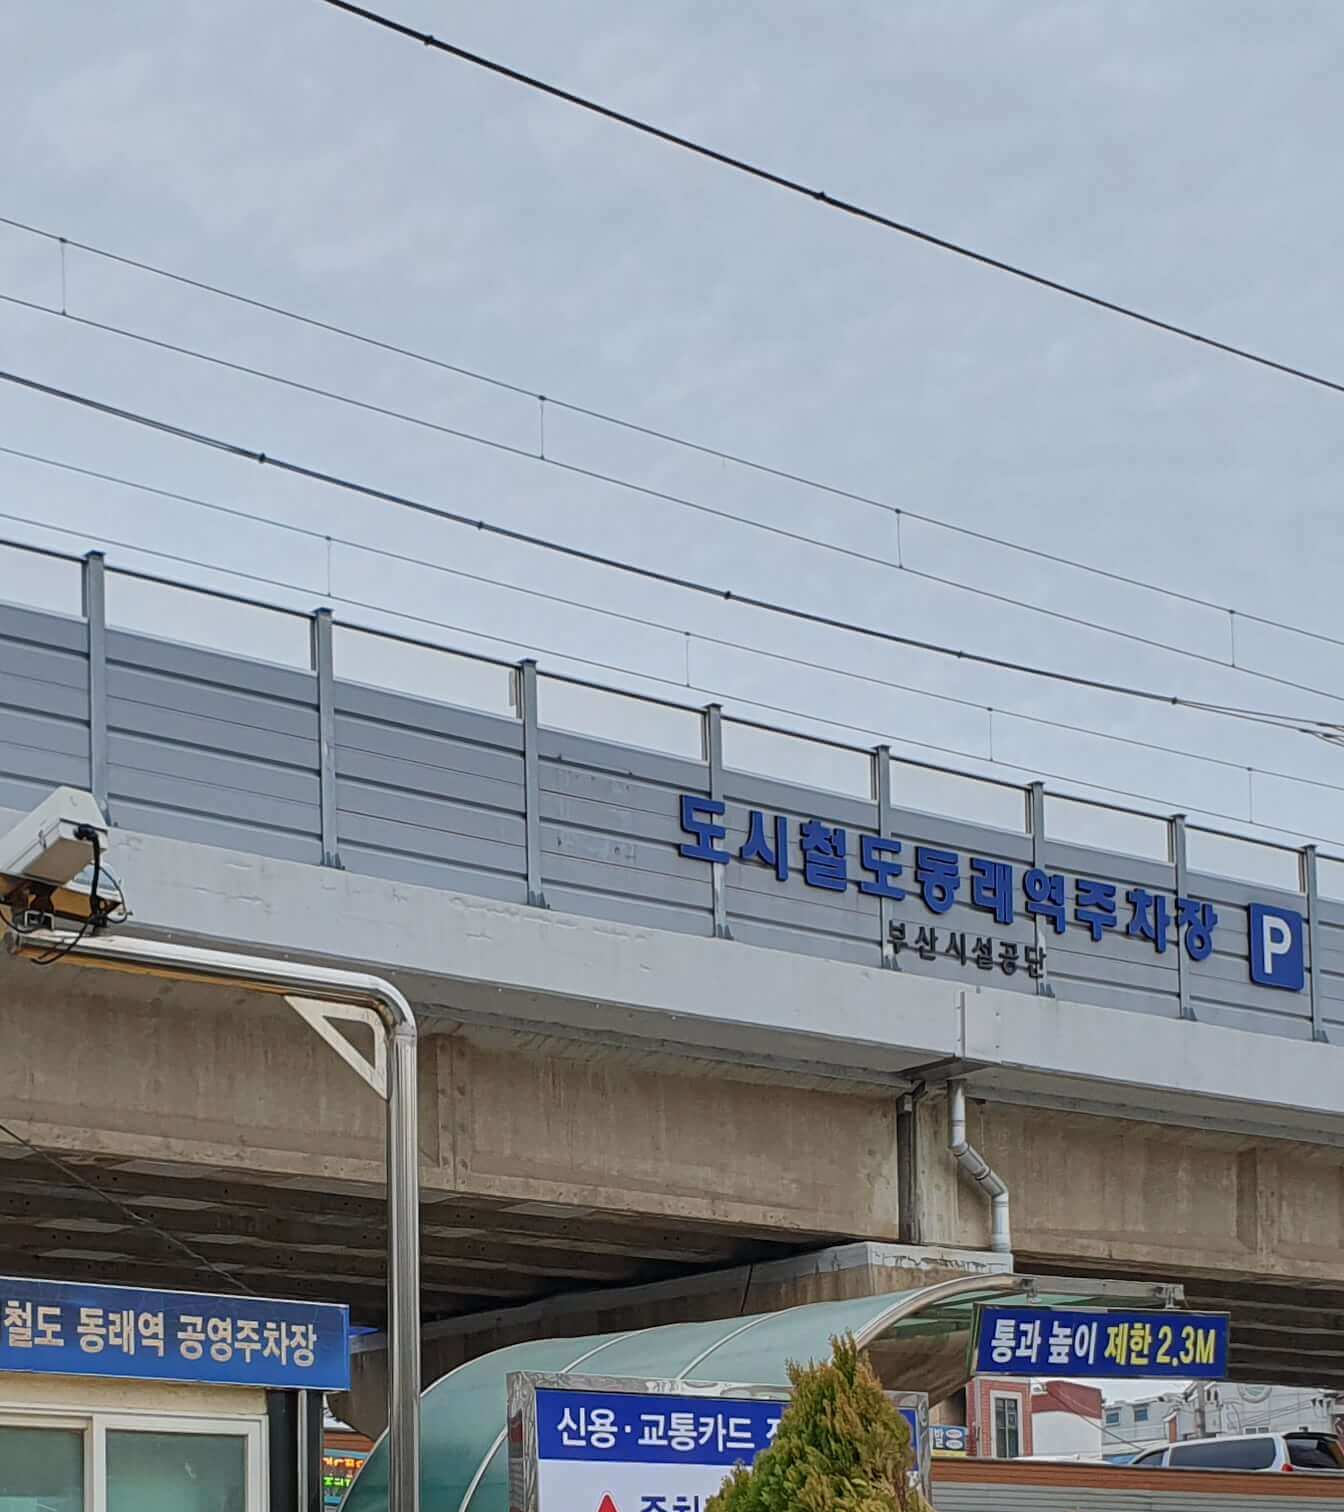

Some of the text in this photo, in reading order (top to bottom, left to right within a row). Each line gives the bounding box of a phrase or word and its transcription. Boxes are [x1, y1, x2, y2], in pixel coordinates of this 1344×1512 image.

[679, 793, 1218, 962] 도시철도동래역주차장
[887, 918, 1048, 980] 부산시설공단
[1262, 914, 1293, 975] P
[77, 1306, 165, 1357] 동래역
[177, 1314, 319, 1369] 공영주차장
[991, 1318, 1216, 1367] 통과 높이 제한 2.3M
